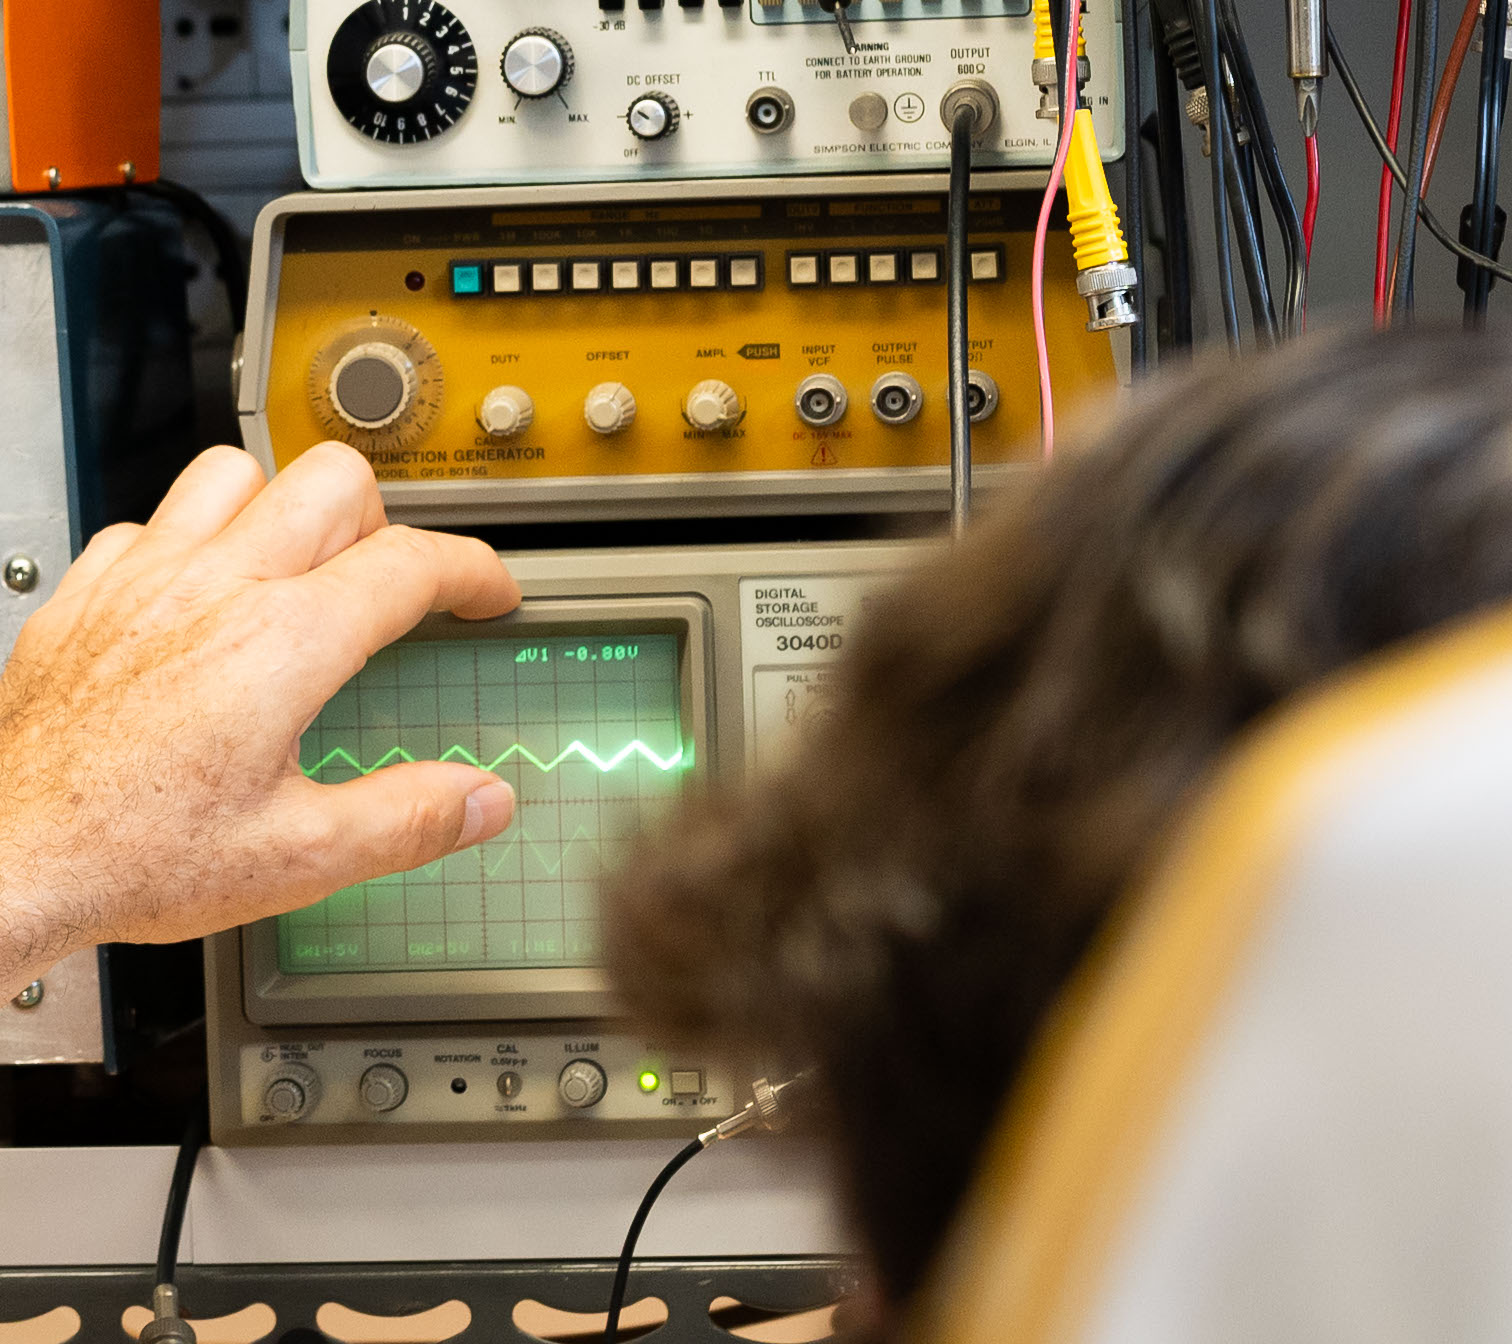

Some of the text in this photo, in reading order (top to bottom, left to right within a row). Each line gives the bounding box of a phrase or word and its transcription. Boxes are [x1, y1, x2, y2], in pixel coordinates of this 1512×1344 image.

[402, 6, 409, 21] 1
[419, 12, 431, 26] 2
[436, 26, 449, 39] 3
[950, 47, 990, 59] OUTPUT
[805, 53, 932, 68] CONNECT TO EARTH GROUND
[626, 74, 681, 86] DC OFFSET
[758, 71, 777, 82] TTL
[815, 69, 834, 80] FOR
[836, 68, 873, 79] BATTERY
[623, 148, 639, 158] OFF
[813, 142, 866, 155] SIMPSON
[870, 141, 921, 153] ELECTRIC
[695, 346, 778, 359] AMPL PUSH
[801, 345, 836, 355] INPUT
[872, 342, 918, 353] OUTPUT
[491, 354, 520, 364] DUTY
[585, 350, 631, 361] OFFSET
[808, 356, 831, 367] VCF
[875, 354, 914, 365] PULSE
[682, 429, 746, 441] MIN MAX
[369, 448, 545, 464] FUNCTION GENERATOR
[755, 588, 807, 600] DIGITAL
[756, 602, 819, 614] STORAGE
[756, 615, 844, 628] OSCILLOSCOPE
[776, 633, 843, 651] 3040D
[364, 1048, 403, 1058] FOCUS
[496, 1043, 519, 1054] CAL
[564, 1043, 600, 1054] ILLUM
[434, 1054, 482, 1064] ROTATION
